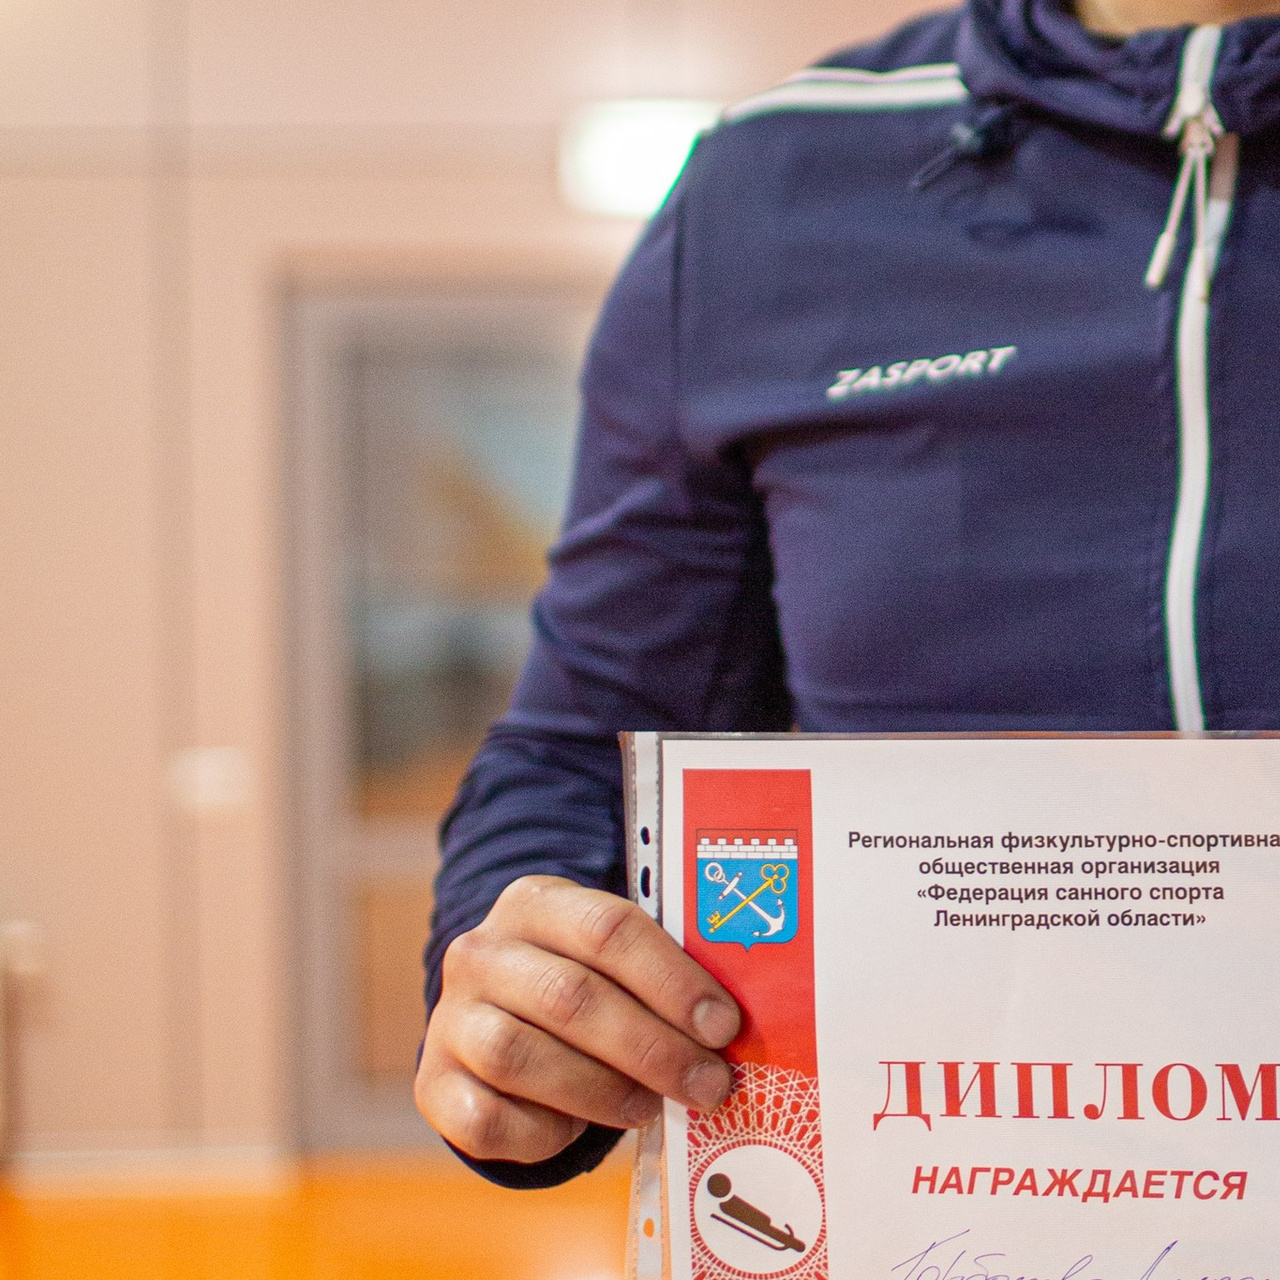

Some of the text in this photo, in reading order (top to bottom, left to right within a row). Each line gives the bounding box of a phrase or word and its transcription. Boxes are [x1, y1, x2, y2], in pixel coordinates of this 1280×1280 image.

[826, 345, 1017, 400] ZASPORT
[848, 831, 994, 849] Региональная
[918, 857, 1220, 879] общественная организация
[917, 883, 1225, 905] «Федерация санного спорта
[933, 908, 1206, 931] Ленинградской области»
[911, 1165, 1248, 1204] НАГРАЖДАЕТСЯ
